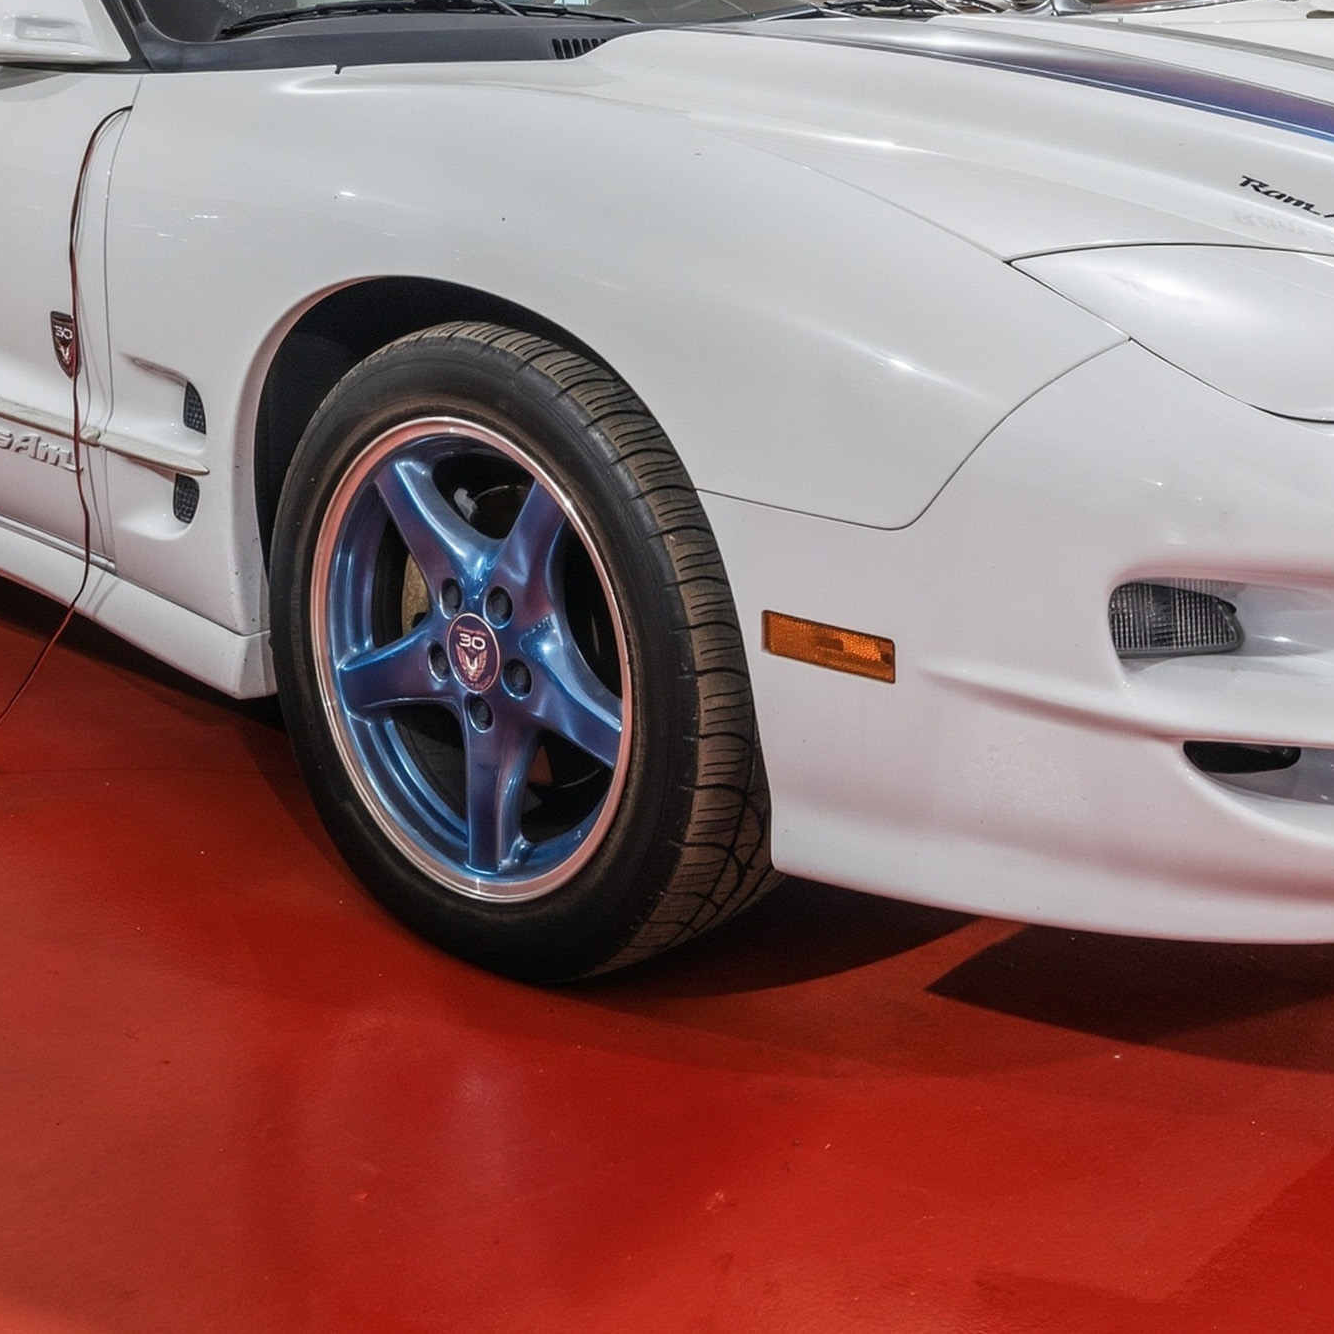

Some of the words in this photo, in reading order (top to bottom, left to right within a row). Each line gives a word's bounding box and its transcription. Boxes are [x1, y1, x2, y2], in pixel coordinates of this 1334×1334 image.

[1239, 176, 1321, 215] Ram
[15, 431, 85, 473] Am
[458, 632, 486, 651] 30
